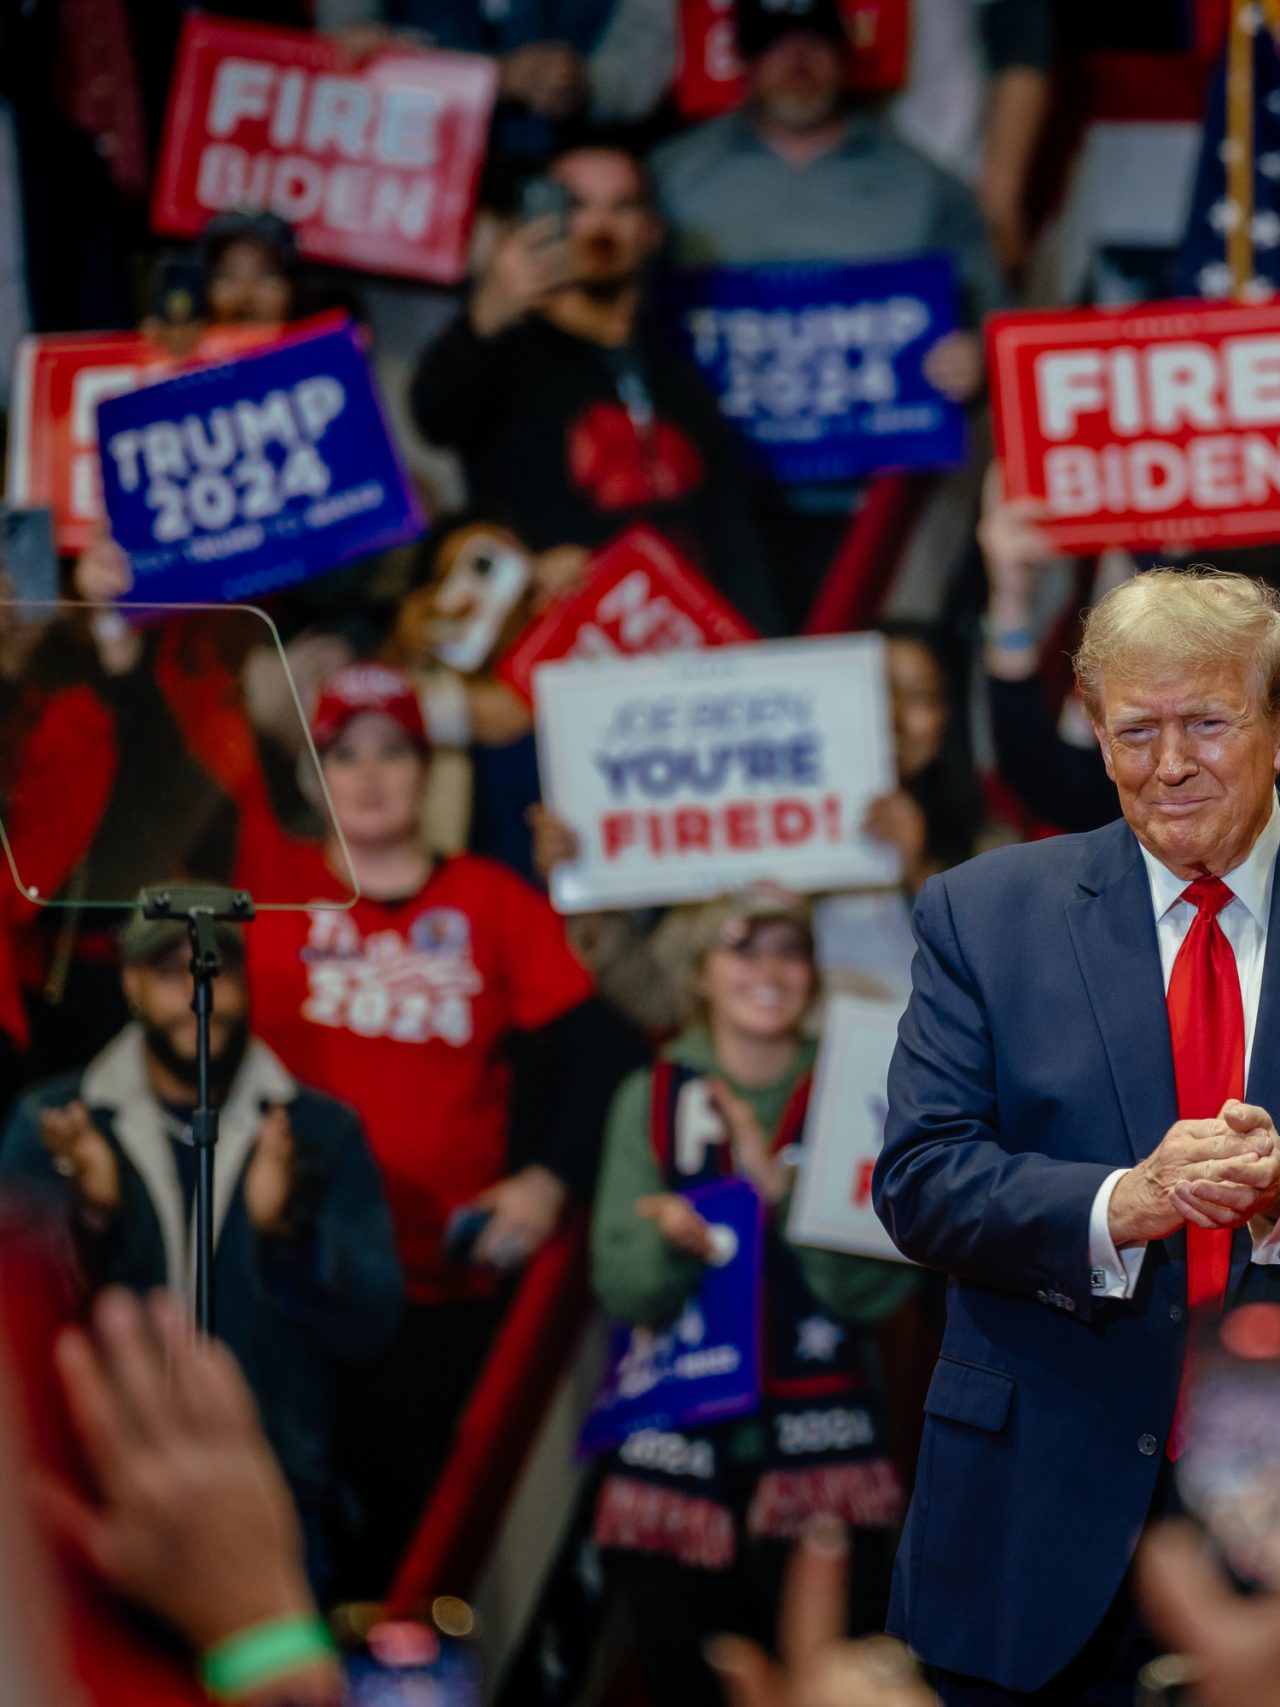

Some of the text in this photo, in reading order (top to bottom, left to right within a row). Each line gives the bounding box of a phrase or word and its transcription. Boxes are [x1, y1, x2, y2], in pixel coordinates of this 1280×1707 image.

[205, 55, 442, 168] FIRE
[195, 140, 435, 242] BIDEN
[687, 296, 930, 366] TRUMP
[109, 374, 346, 494] TRUMP
[148, 443, 331, 541] 2024
[594, 730, 824, 801] YOU'RE
[599, 792, 843, 860] FIRED!
